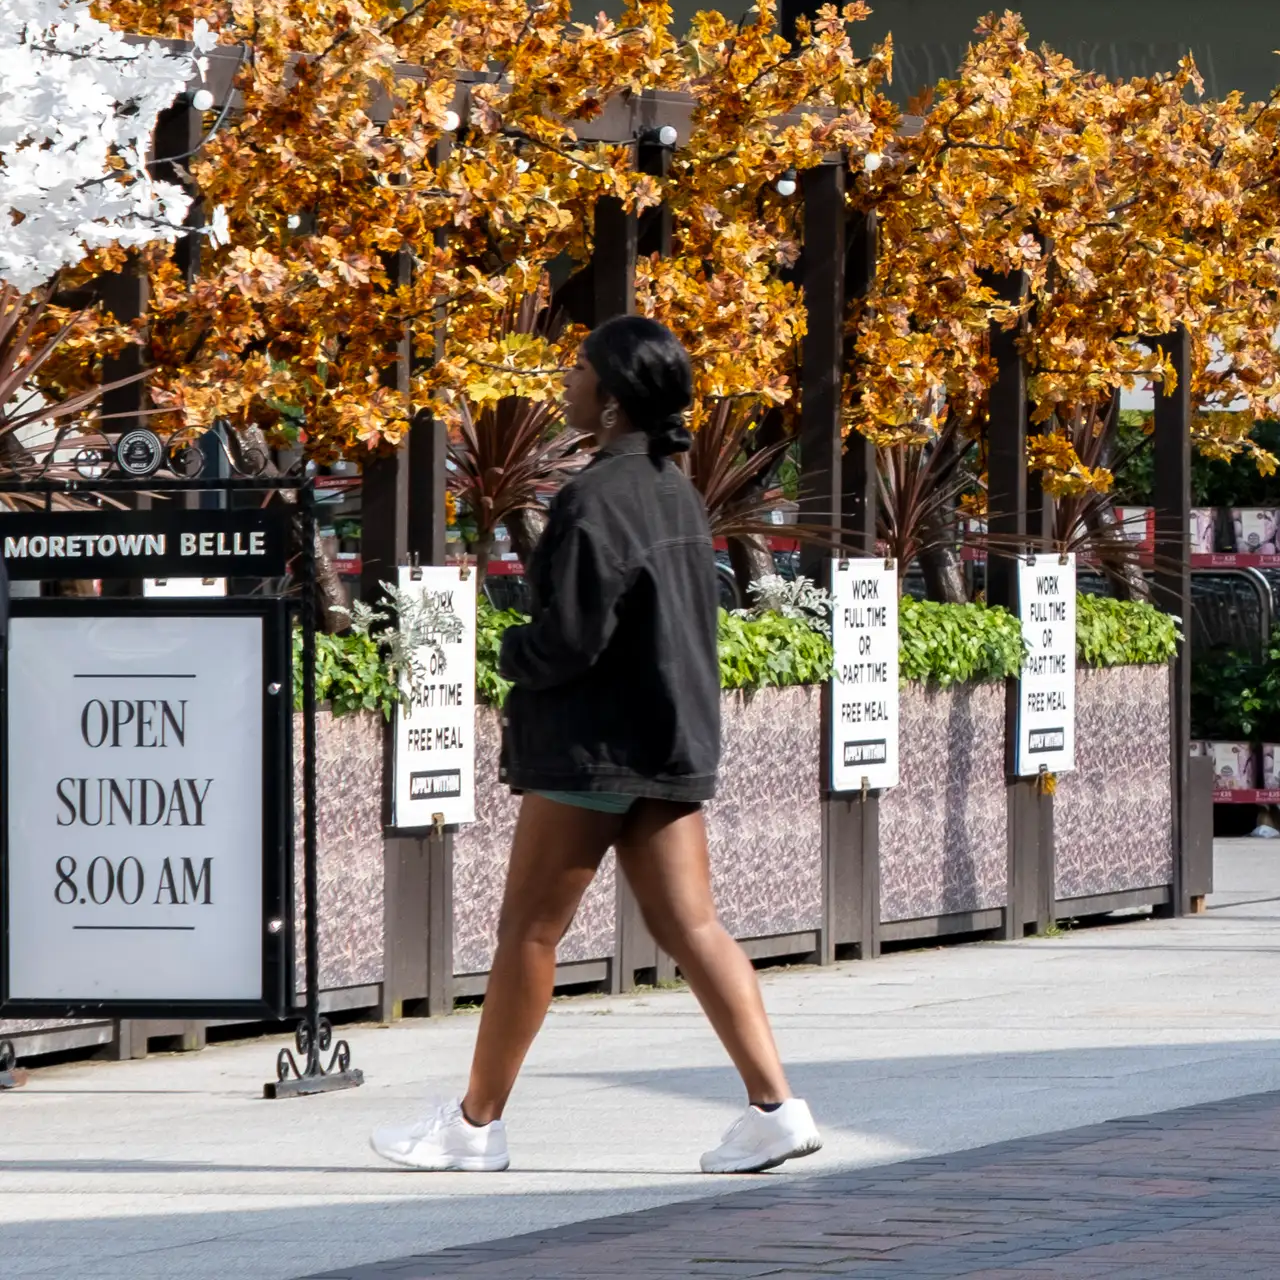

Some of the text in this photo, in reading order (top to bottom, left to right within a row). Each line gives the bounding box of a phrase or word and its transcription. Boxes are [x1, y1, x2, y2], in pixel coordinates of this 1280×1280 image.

[4, 531, 266, 558] MORETOWN BELLE
[852, 579, 879, 600] WORK
[1036, 575, 1059, 595] WORK
[844, 606, 886, 628] FULL TIME
[1030, 601, 1066, 622] FULL TIME
[859, 635, 871, 656] OR
[1042, 628, 1052, 648] OR
[843, 662, 887, 685] PART TIME
[1029, 654, 1066, 675] PART TIME
[439, 683, 462, 707] TIME
[1027, 691, 1066, 713] FREE MEAL
[842, 701, 888, 723] FREE MEAL
[81, 699, 189, 749] OPEN
[408, 726, 463, 751] FREE MEAL
[56, 777, 215, 826] SUNDAY
[54, 855, 214, 905] 8.00 AM
